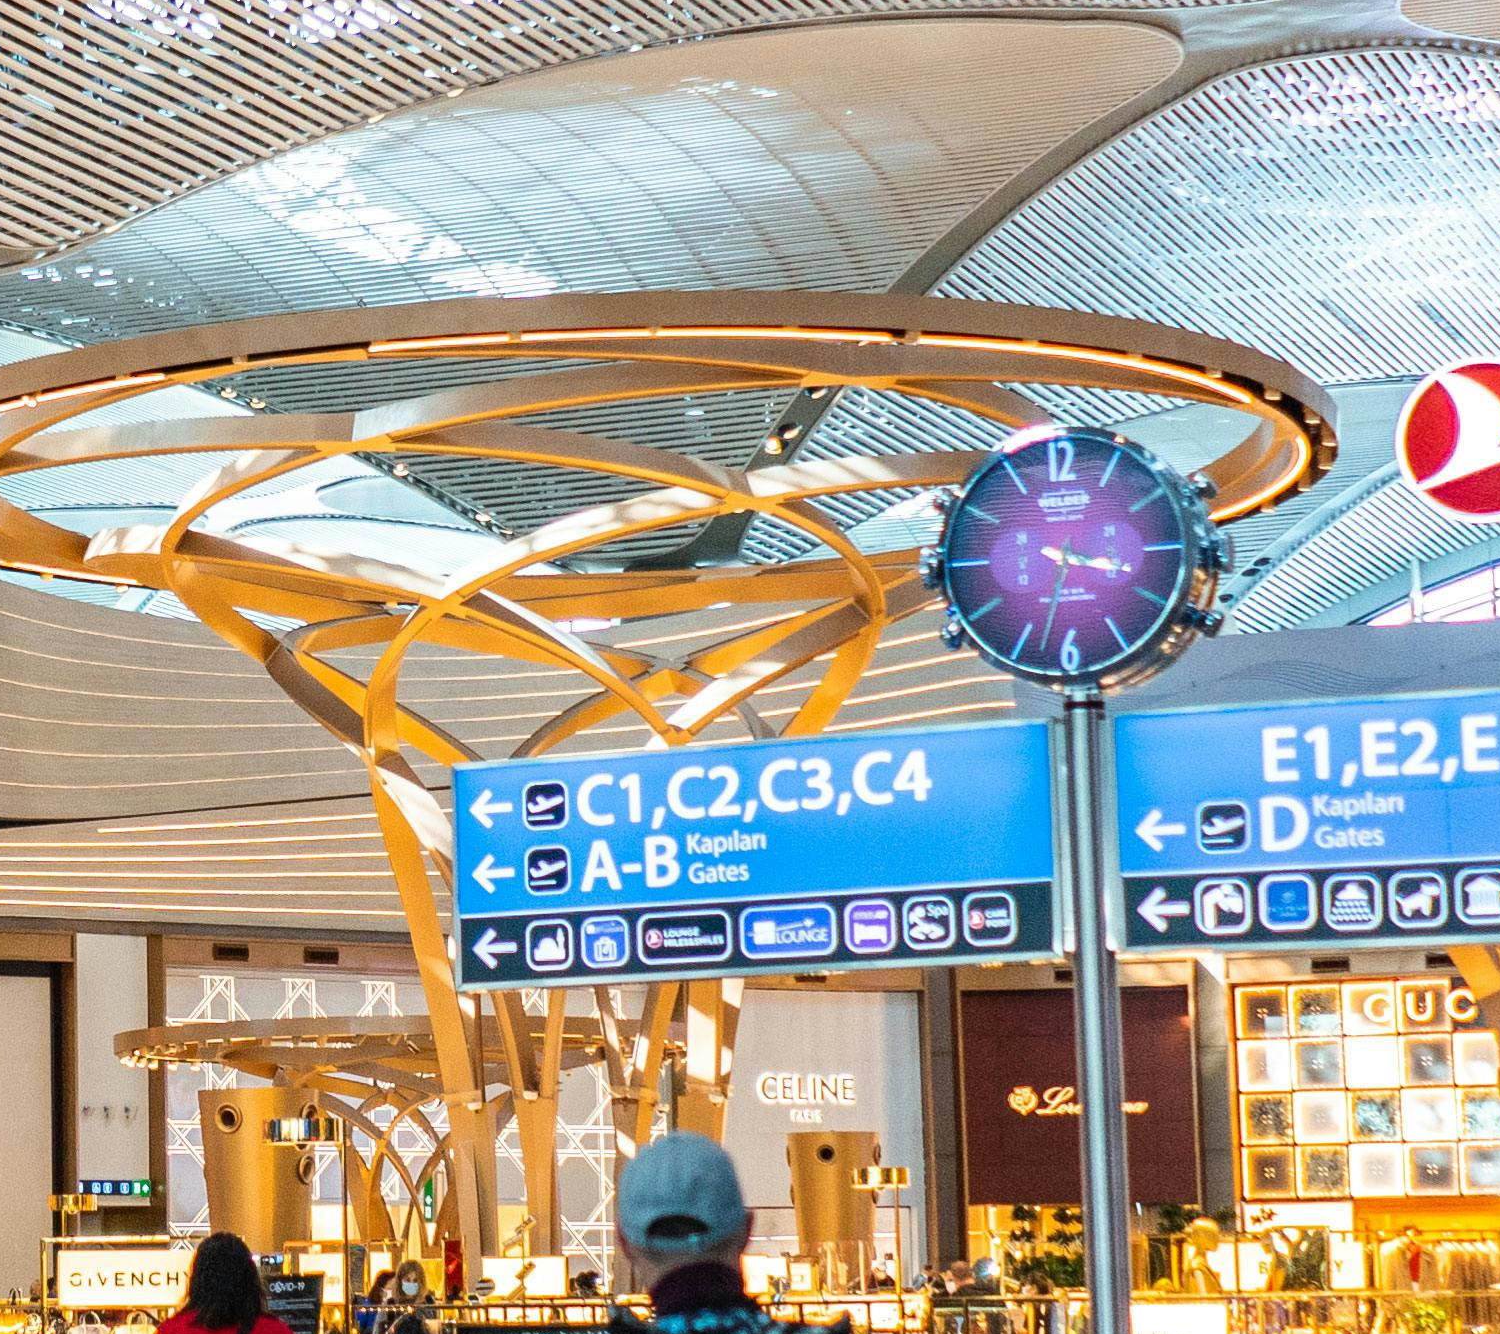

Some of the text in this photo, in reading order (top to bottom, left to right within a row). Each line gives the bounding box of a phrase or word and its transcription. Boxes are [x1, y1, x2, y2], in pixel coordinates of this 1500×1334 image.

[1047, 440, 1077, 483] 12
[1059, 627, 1081, 672] 6
[576, 750, 932, 830] C1,C2,C3,C4
[1259, 791, 1405, 853] D Kapıları
[1314, 824, 1385, 849] Gates
[580, 829, 768, 892] A-B Kapıları
[687, 863, 750, 885] Gates
[774, 927, 829, 944] LOUNGE
[758, 1072, 858, 1105] CELINE
